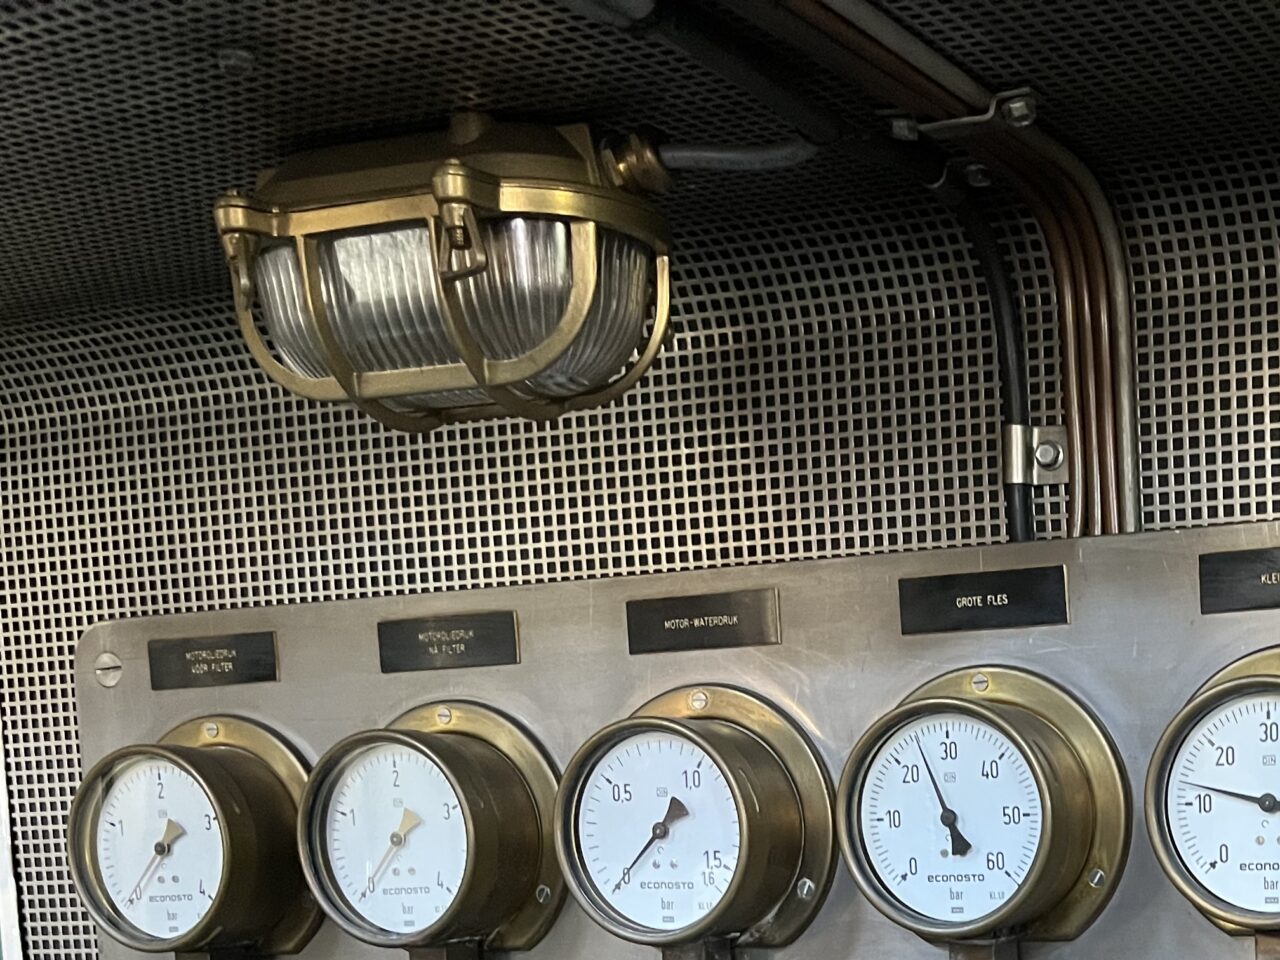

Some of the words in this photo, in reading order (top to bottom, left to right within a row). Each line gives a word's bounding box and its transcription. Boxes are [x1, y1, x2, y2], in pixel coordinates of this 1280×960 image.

[956, 595, 983, 609] GROTE
[987, 593, 1009, 606] FLES
[664, 615, 739, 630] MOTOR-WATERDRUK
[1259, 722, 1279, 742] 30
[939, 741, 958, 760] 30
[1215, 746, 1235, 766] 20
[392, 770, 400, 787] 2
[902, 764, 920, 783] 20
[981, 760, 999, 779] 40
[682, 770, 701, 790] 1,0
[157, 782, 165, 799] 2
[612, 784, 632, 803] 0,5
[443, 802, 451, 820] 3
[1195, 793, 1212, 813] 10
[204, 814, 212, 831] 3
[350, 808, 356, 826] 1
[885, 810, 901, 828] 10
[1002, 806, 1021, 825] 50
[119, 820, 124, 837] 1
[986, 852, 1005, 871] 60
[1219, 844, 1229, 863] 0
[909, 857, 918, 875] 0
[367, 876, 375, 893] 0
[436, 871, 443, 889] 4
[622, 867, 631, 884] 0
[927, 873, 985, 882] econosto
[1263, 877, 1279, 890] bar
[199, 879, 206, 896] 4
[640, 881, 694, 890] econosto
[949, 888, 963, 901] bar
[661, 897, 674, 910] bar
